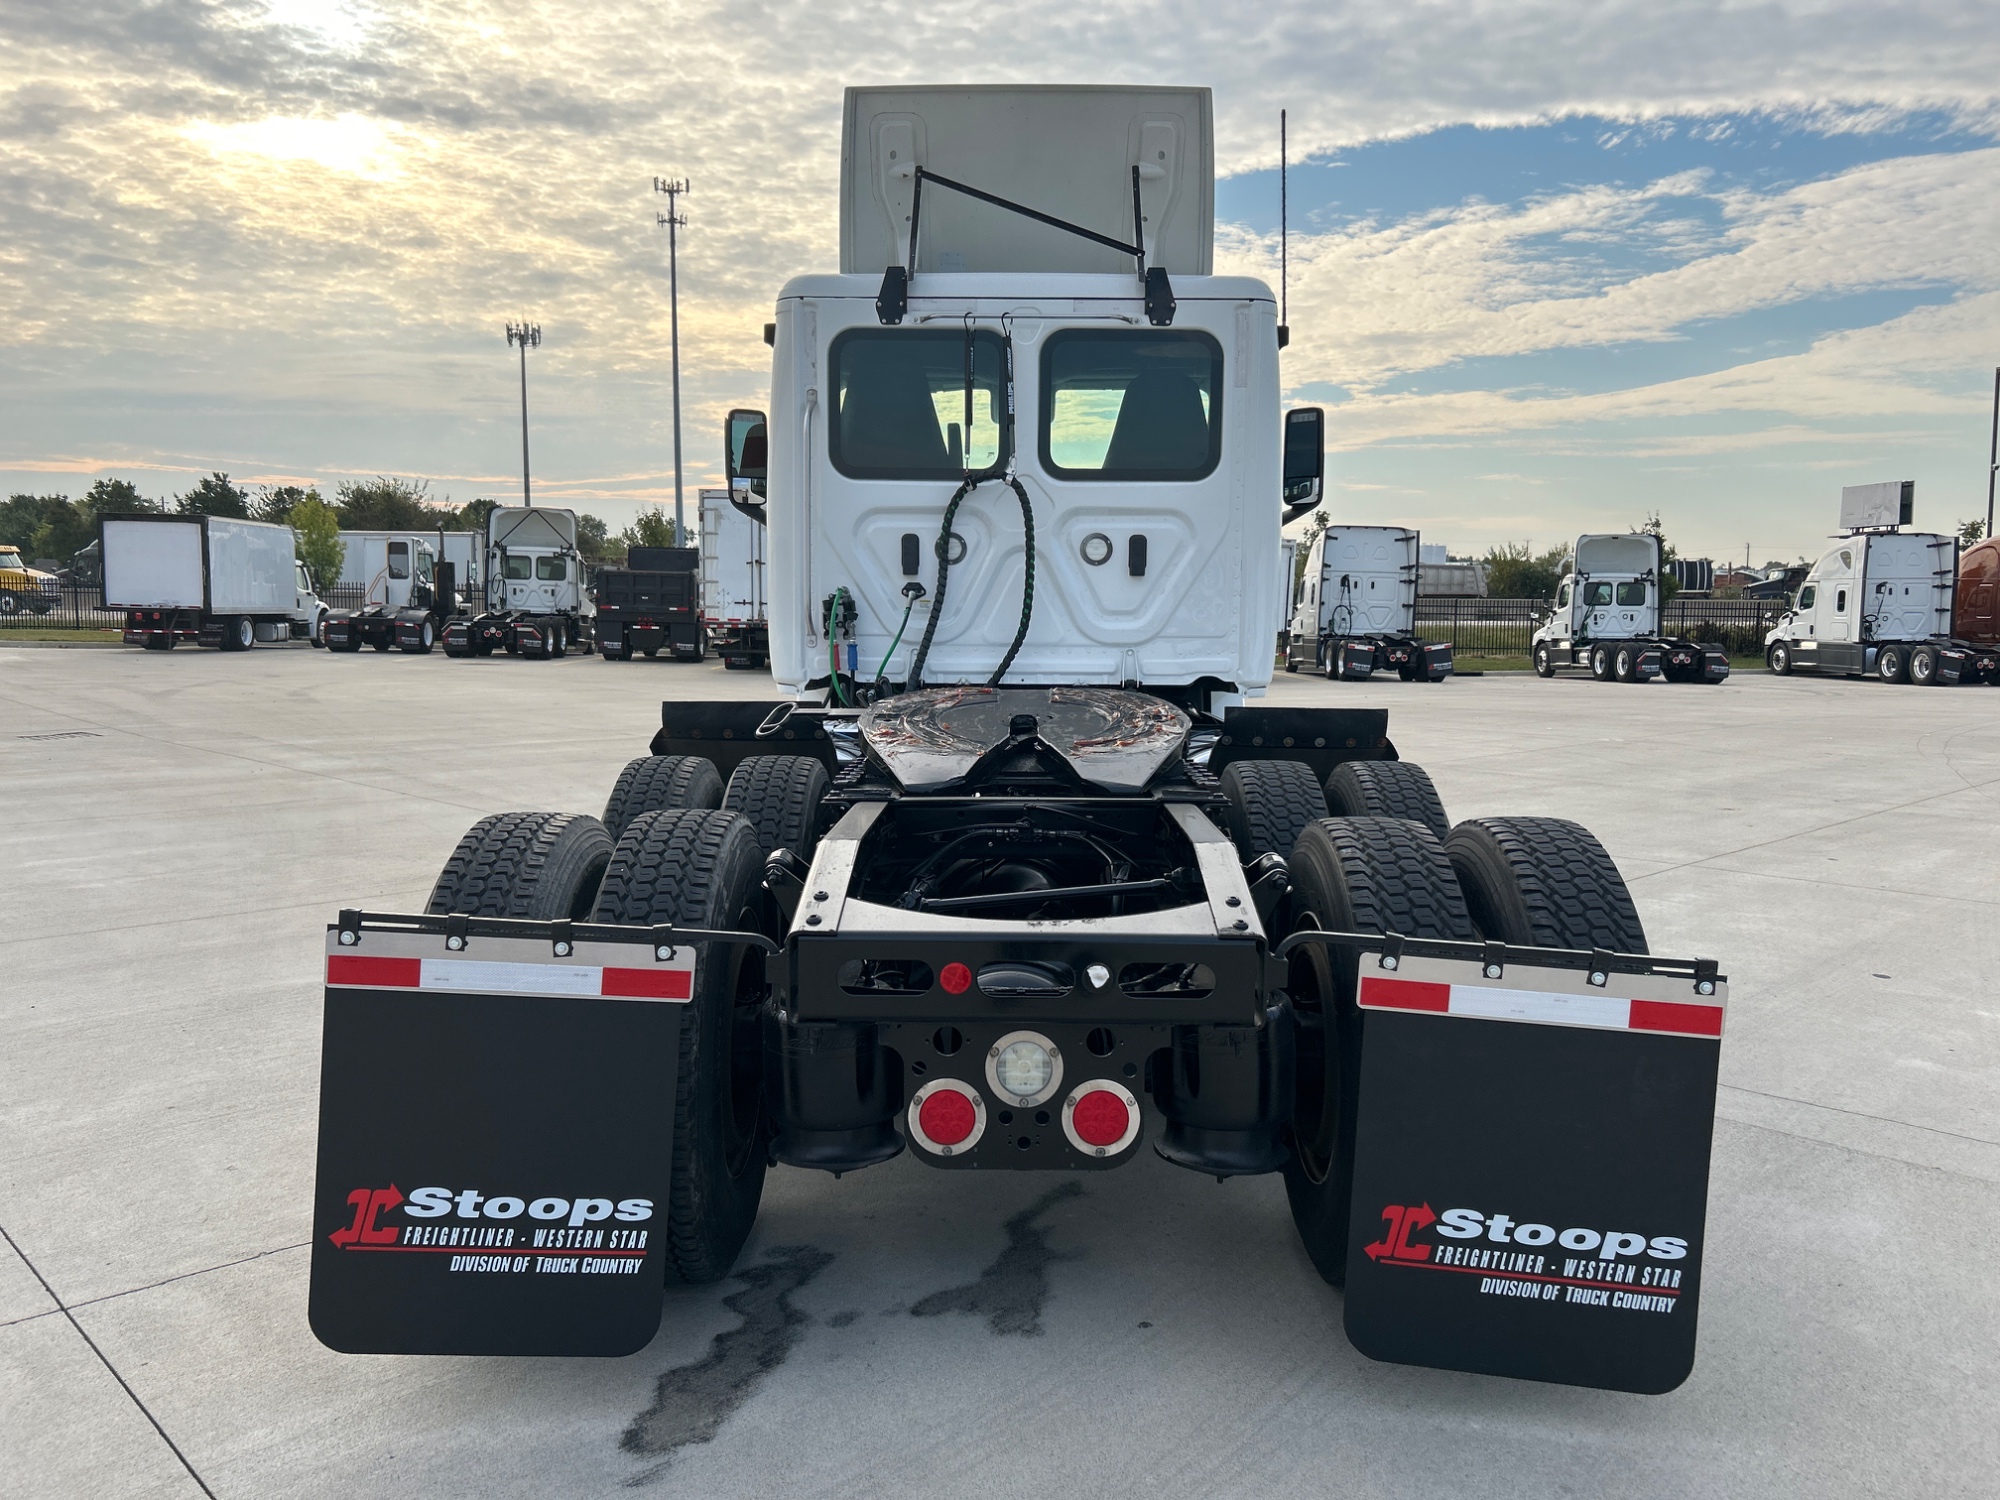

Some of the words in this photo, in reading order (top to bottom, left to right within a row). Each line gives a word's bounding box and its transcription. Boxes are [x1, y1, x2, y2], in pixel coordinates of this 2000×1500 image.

[403, 1186, 654, 1227] Stoops
[403, 1226, 515, 1247] FREIGHTLINER
[532, 1228, 605, 1249] WESTERN
[609, 1229, 648, 1249] STAR
[1435, 1208, 1689, 1261] Stoops
[449, 1255, 512, 1273] DIVISION
[512, 1256, 531, 1273] OF
[535, 1256, 580, 1274] TRUCK
[581, 1257, 644, 1274] COUNTRY
[1434, 1245, 1545, 1274] FREIGHTLINER
[1562, 1258, 1637, 1284] WESTERN
[1641, 1266, 1682, 1289] STAR
[1480, 1277, 1542, 1299] DIVISION
[1542, 1284, 1561, 1301] OF
[1565, 1286, 1611, 1307] TRUCK
[1611, 1291, 1677, 1314] COUNTRY
